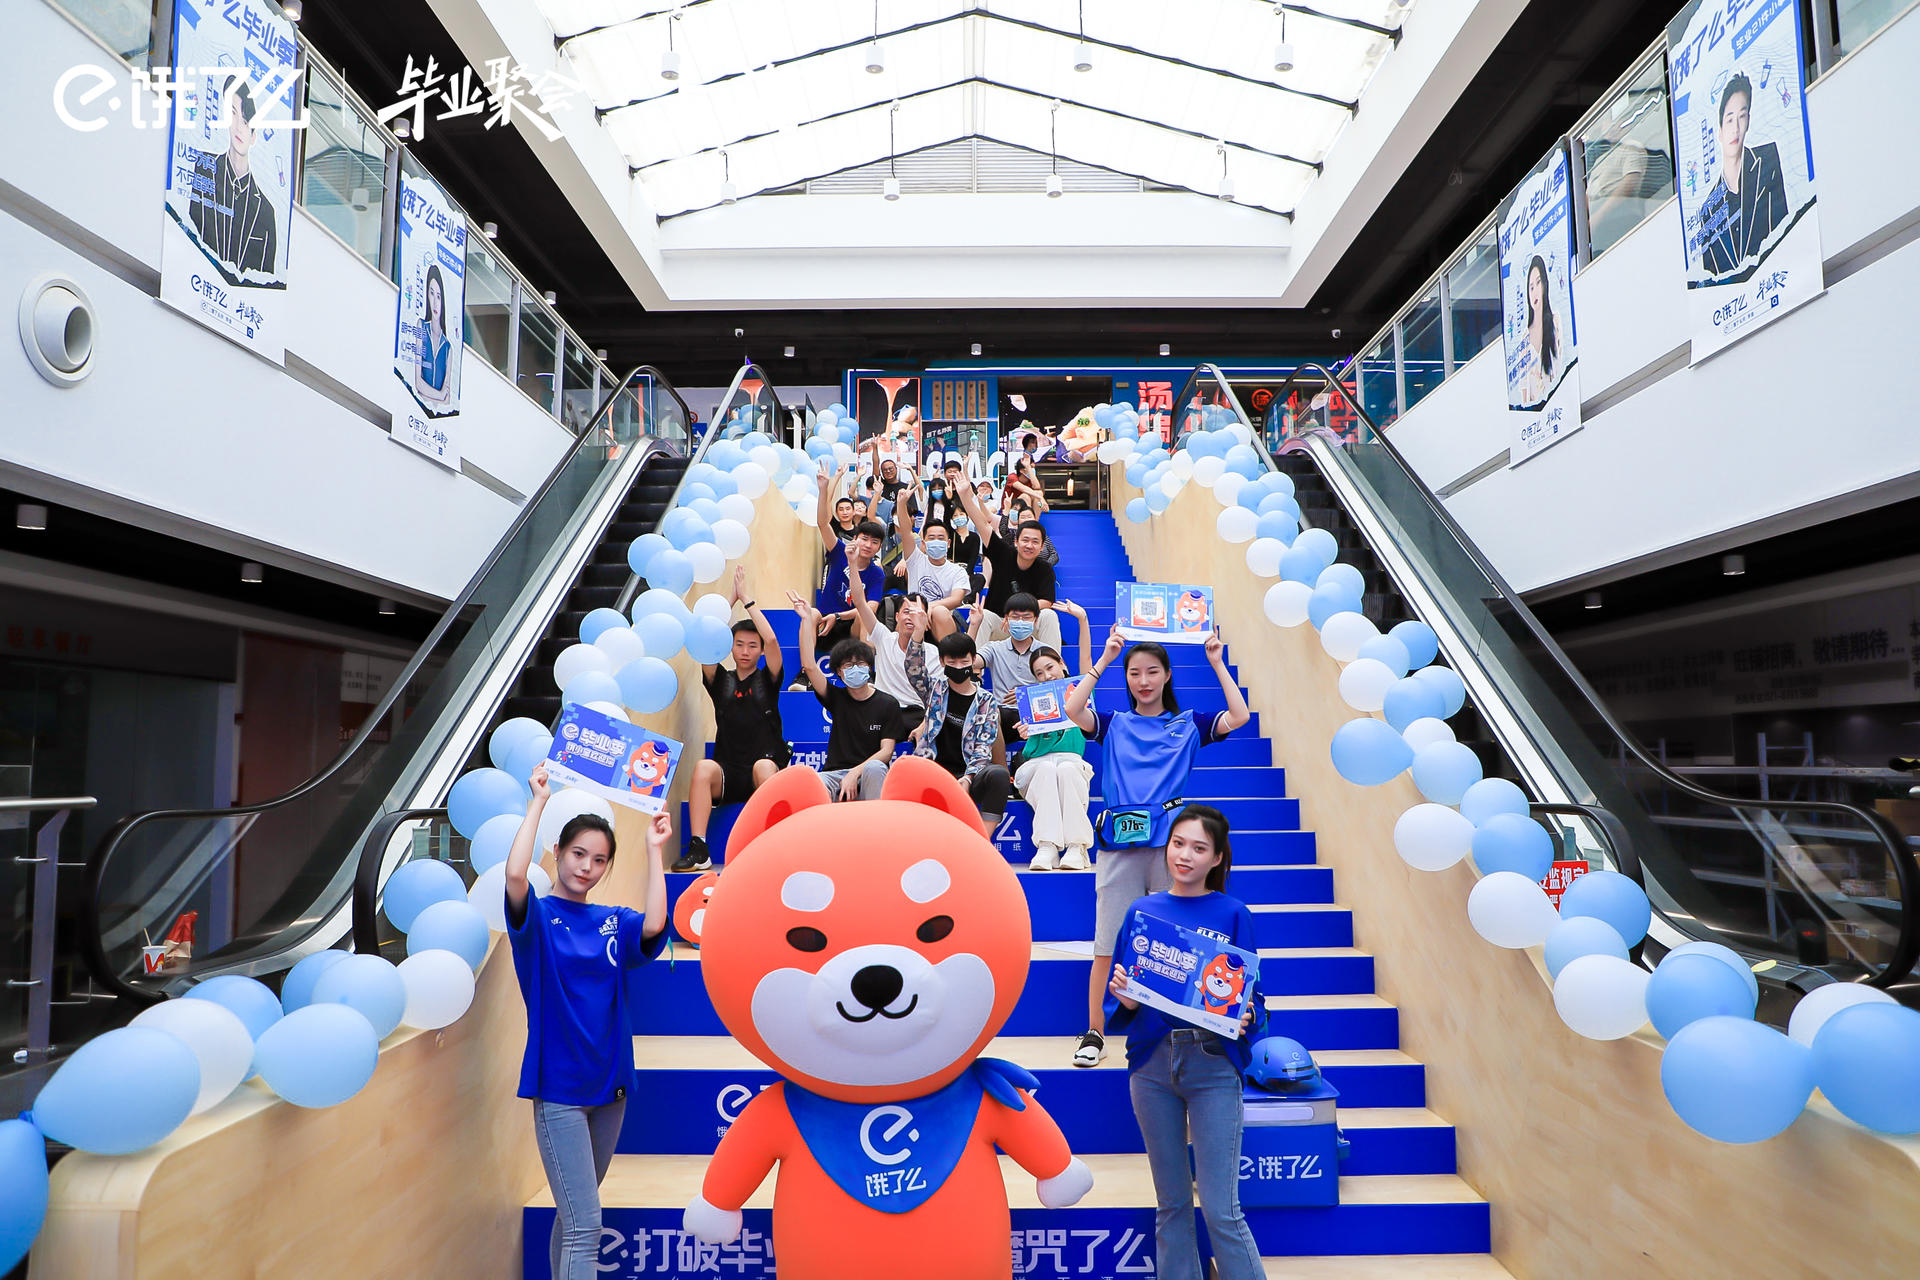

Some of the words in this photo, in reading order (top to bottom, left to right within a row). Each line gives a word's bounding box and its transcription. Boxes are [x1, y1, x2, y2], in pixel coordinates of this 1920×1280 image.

[205, 0, 295, 66] 么毕业季
[1671, 0, 1750, 91] 饿了么毕
[403, 186, 465, 248] 饿了么毕业季
[1501, 160, 1565, 260] 饿了么毕业季
[203, 280, 228, 309] 饿了么
[1722, 293, 1747, 321] 饿了么
[579, 727, 627, 757] 毕业季
[1149, 940, 1198, 972] 毕业季
[865, 1167, 927, 1197] 饿了么
[1258, 1155, 1322, 1180] 饿了么
[634, 1228, 775, 1273] 打破毕
